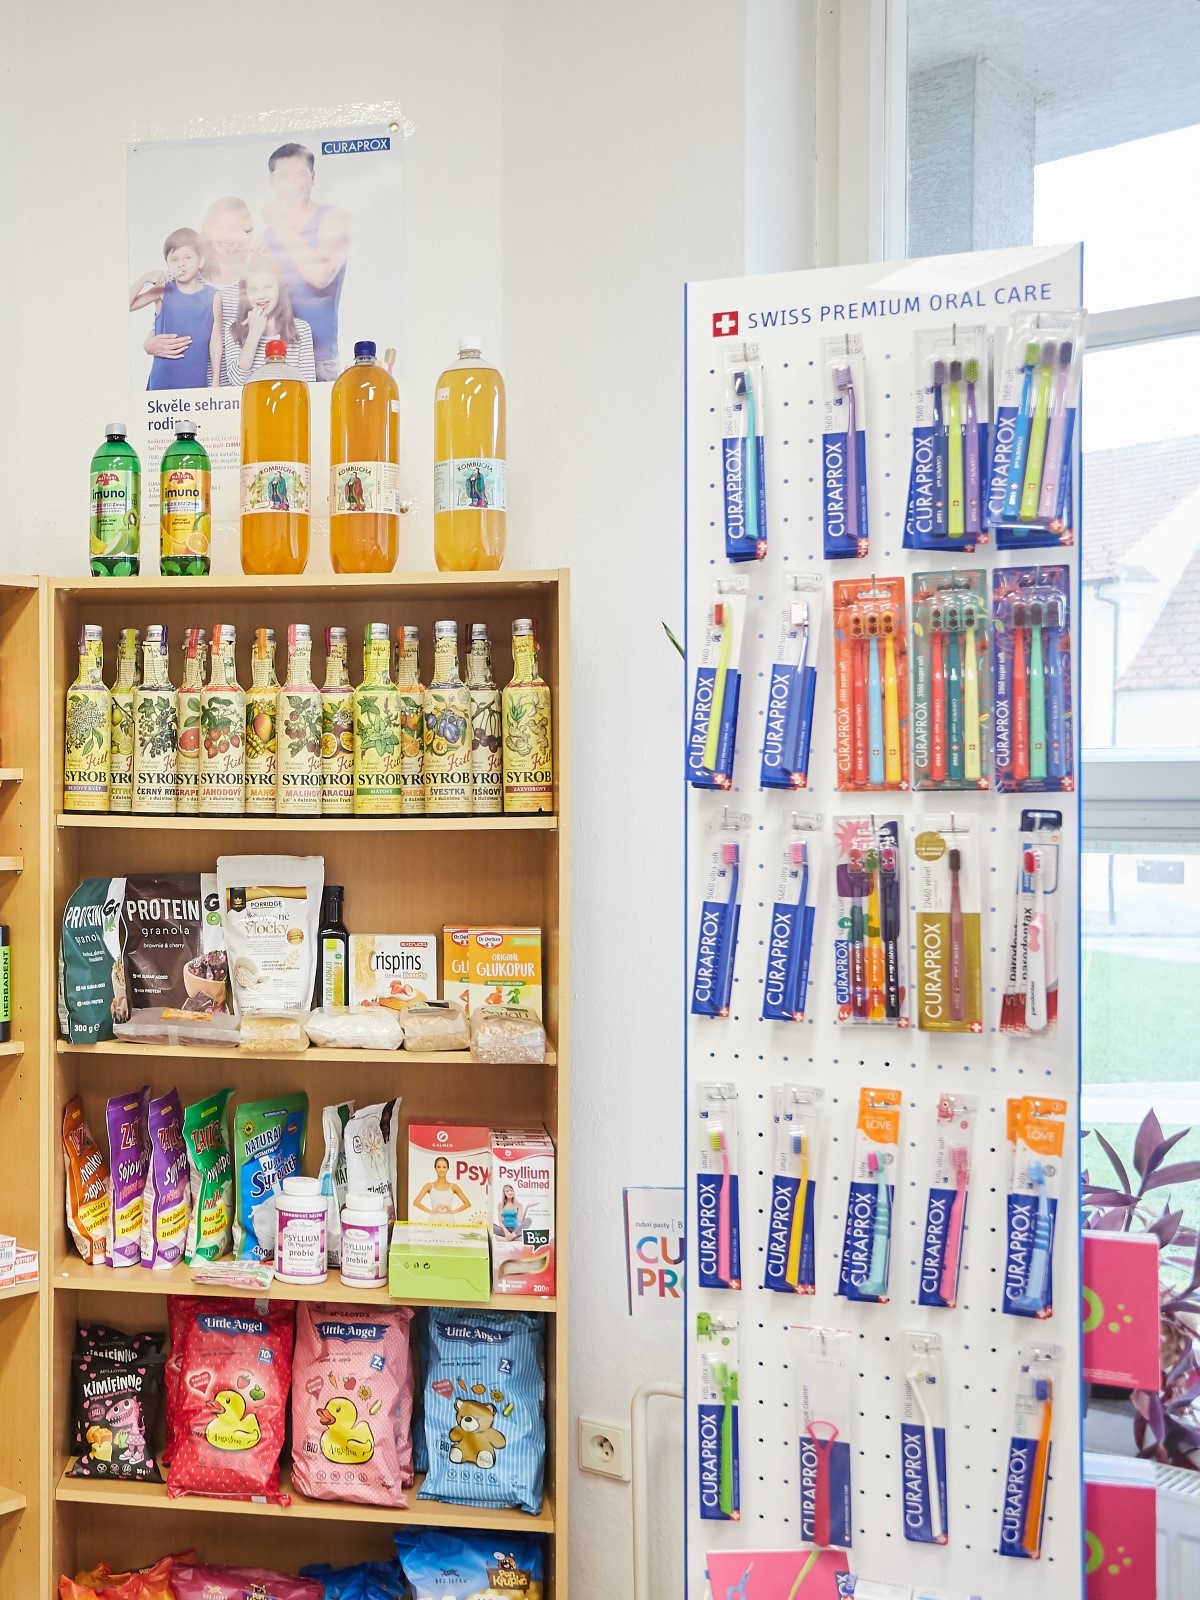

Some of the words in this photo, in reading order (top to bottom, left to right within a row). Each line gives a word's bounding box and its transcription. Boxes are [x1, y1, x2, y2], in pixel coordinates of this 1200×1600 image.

[324, 139, 387, 154] CURAPROX
[748, 307, 811, 329] SWISS
[820, 297, 921, 322] PREMIUM
[930, 290, 986, 311] ORAL
[994, 284, 1052, 305] CARE
[148, 399, 190, 413] Skvěle
[195, 398, 239, 411] sehran
[825, 415, 833, 431] 1560
[259, 466, 297, 478] KOMBUCHA
[338, 465, 372, 477] KOMBUCHA
[457, 464, 493, 474] KOMBUCHA
[827, 442, 844, 537] CURAPROX
[917, 436, 933, 533] CURAPROX
[93, 489, 125, 500] imuno
[165, 488, 199, 498] imuno
[725, 447, 741, 539] CURAPROX
[705, 627, 713, 646] super
[689, 677, 714, 767] CURAPROX
[764, 673, 790, 767] CURAPROX
[838, 706, 850, 772] CURAPROX
[915, 701, 927, 767] CURAPROX
[996, 699, 1008, 767] CURAPROX
[65, 771, 106, 783] SYROB
[201, 773, 244, 785] SYROB
[426, 773, 470, 784] SYROB
[507, 772, 551, 783] SYROB
[202, 787, 241, 796] JAHODOVÝ
[430, 787, 465, 796] ŠVESTKA
[127, 900, 200, 921] PROTEIN
[142, 927, 189, 938] granola
[369, 951, 421, 971] Crispins
[695, 912, 720, 1002] CURAPROX
[767, 913, 790, 1006] CURAPROX
[477, 962, 535, 977] GLUKOPUR
[925, 923, 940, 1018] CURAPROX
[74, 1024, 87, 1032] 300
[866, 1120, 892, 1131] LOVE
[1028, 1130, 1054, 1142] LOVE
[499, 1166, 549, 1183] Psyllium
[518, 1180, 549, 1189] Galmed
[654, 1222, 670, 1230] pasty
[700, 1184, 715, 1275] CURAPROX
[770, 1186, 791, 1278] CURAPROX
[284, 1234, 320, 1242] PSYLLIUM
[527, 1232, 547, 1244] Bio
[289, 1249, 314, 1258] probio
[922, 1199, 946, 1293] CURAPROX
[346, 1257, 367, 1265] probio
[205, 1317, 231, 1329] Little
[232, 1320, 263, 1332] Angel
[322, 1325, 345, 1335] Little
[346, 1326, 376, 1339] Angel
[445, 1327, 471, 1338] Little
[472, 1329, 502, 1342] Angel
[702, 1414, 717, 1507] CURAPROX
[905, 1433, 923, 1528] CURAPROX
[1002, 1448, 1029, 1543] CURAPROX
[500, 1569, 515, 1579] Pan
[493, 1575, 528, 1589] Krupka
